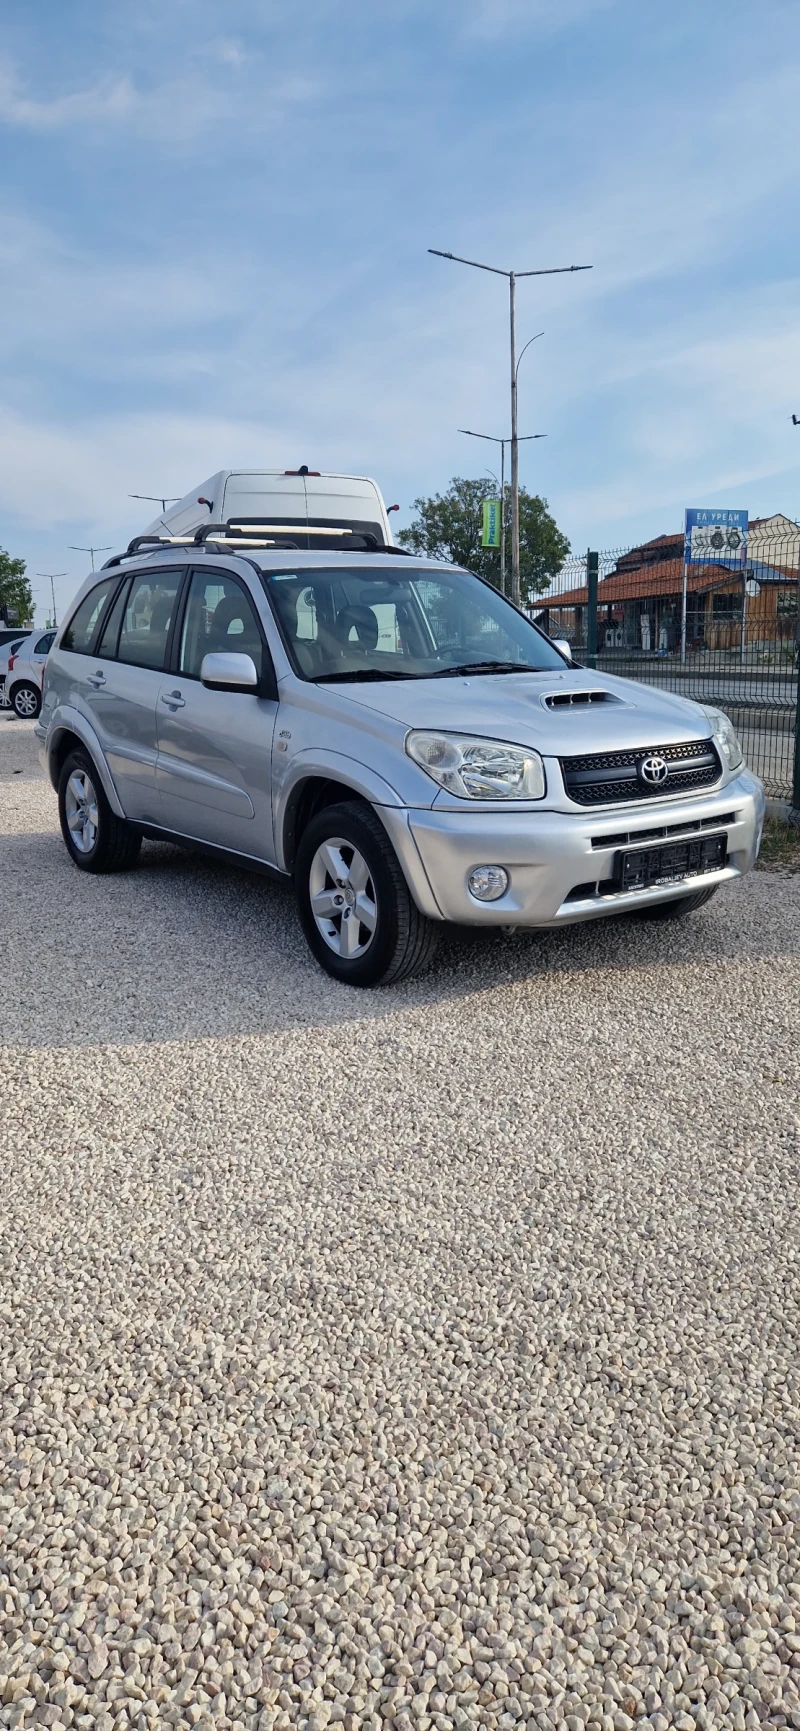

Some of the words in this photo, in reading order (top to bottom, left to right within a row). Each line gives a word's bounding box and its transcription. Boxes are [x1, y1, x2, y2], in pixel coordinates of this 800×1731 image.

[488, 504, 496, 544] Praktiker
[696, 512, 707, 520] ЕЛ
[711, 513, 740, 522] УРЕДИ
